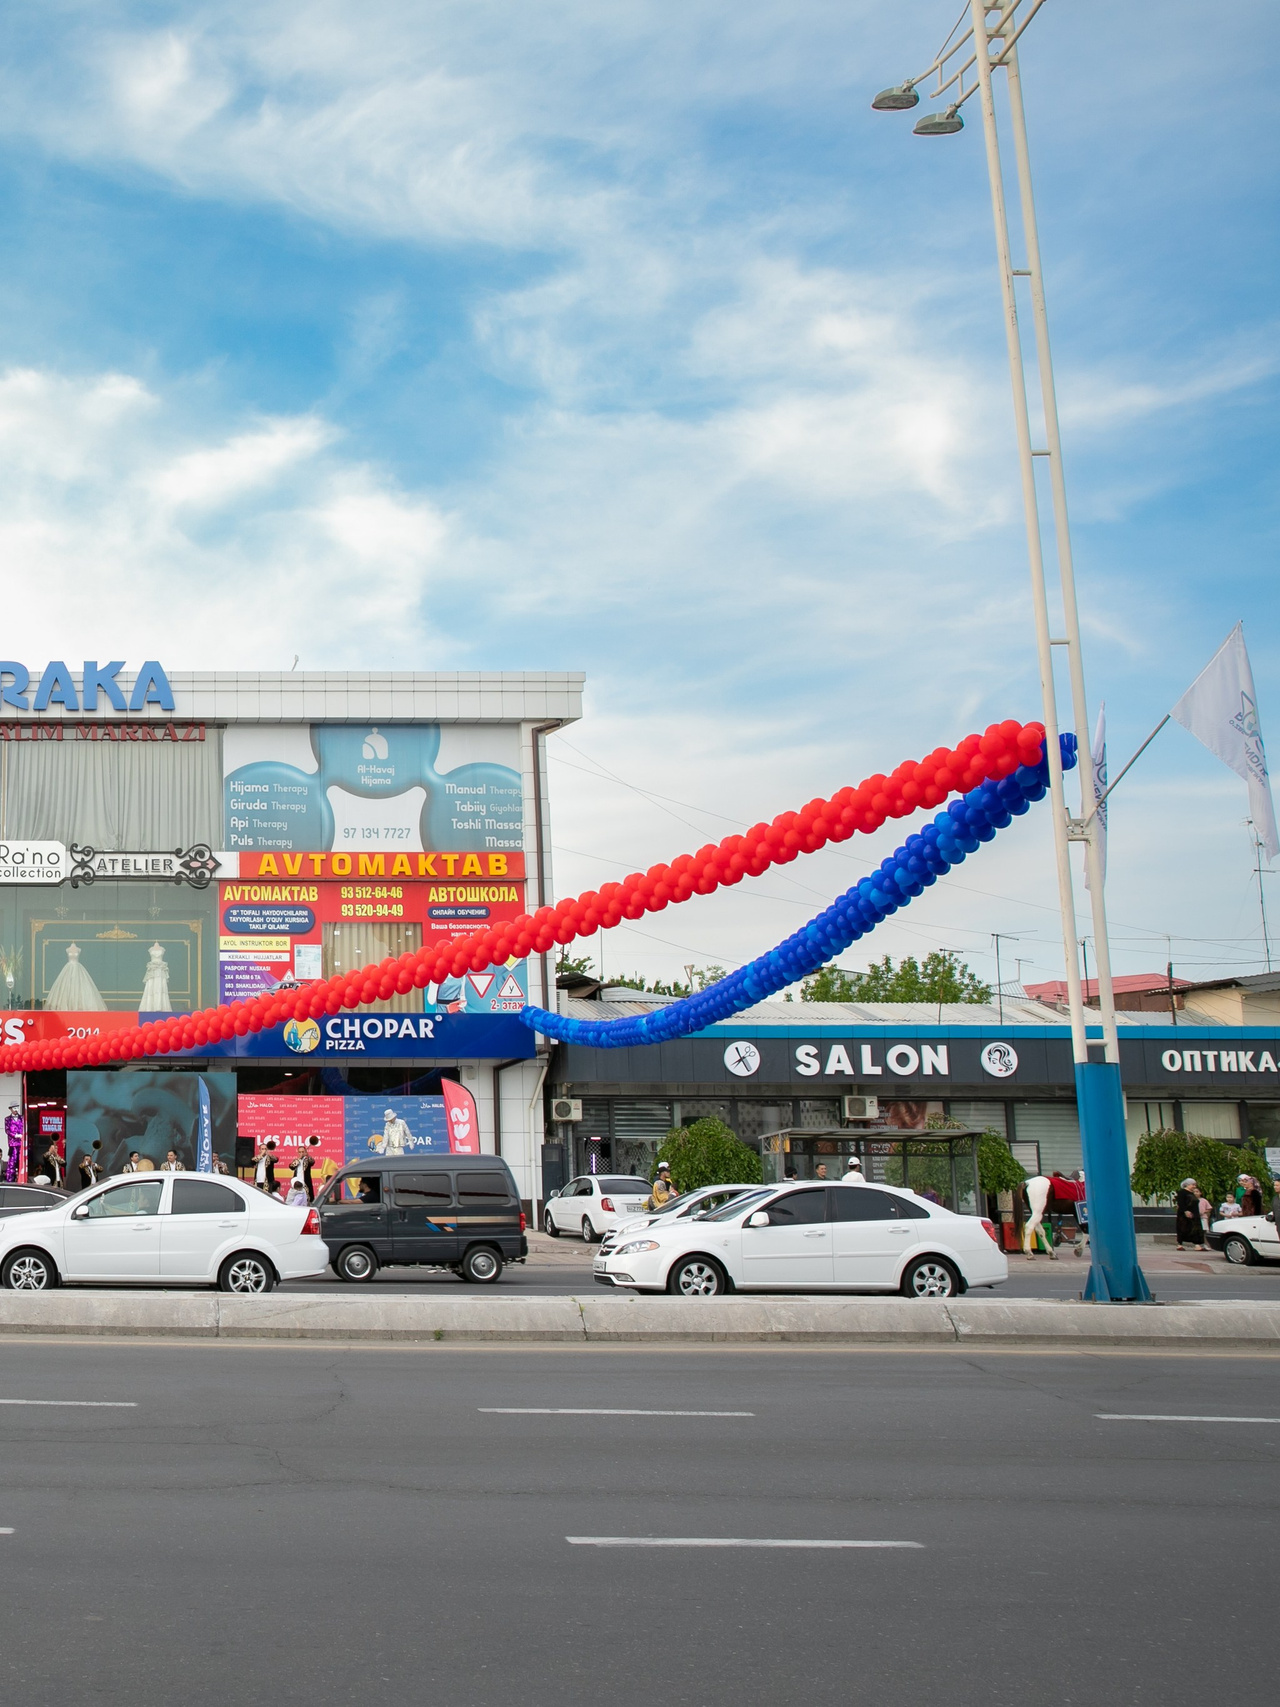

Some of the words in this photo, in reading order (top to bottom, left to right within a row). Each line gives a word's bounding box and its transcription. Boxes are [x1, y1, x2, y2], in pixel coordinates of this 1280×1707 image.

[75, 722, 206, 742] MARKAZI
[357, 765, 395, 776] Al-Havaj
[230, 781, 269, 795] Hijama
[273, 784, 308, 795] Therapy
[361, 776, 391, 787] Hijama
[445, 783, 486, 795] Manual
[230, 799, 267, 810] Giruda
[271, 801, 307, 813] Therapy
[455, 801, 486, 815] Tabiiy
[230, 816, 249, 831] Api
[252, 819, 288, 831] Therapy
[451, 818, 481, 830] Toshli
[343, 828, 356, 839] 97
[362, 828, 379, 839] 134
[384, 828, 411, 839] 7727
[231, 834, 254, 846] Puls
[257, 836, 293, 848] Therapy
[97, 858, 174, 871] ATELIER
[258, 853, 509, 876] AVTOMAKTAB
[223, 886, 319, 901] AVTOMAKTAB
[341, 887, 354, 899] 93
[355, 887, 403, 899] 512-64-46
[428, 886, 519, 902] АВТОШКОЛА
[341, 904, 354, 917] 93
[355, 904, 404, 917] 520-94-49
[67, 1027, 101, 1039] 2014
[326, 1018, 434, 1039] CHOPAR
[326, 1040, 365, 1050] PIZZA
[795, 1044, 949, 1076] SALON
[1161, 1050, 1278, 1072] ОПТИКА
